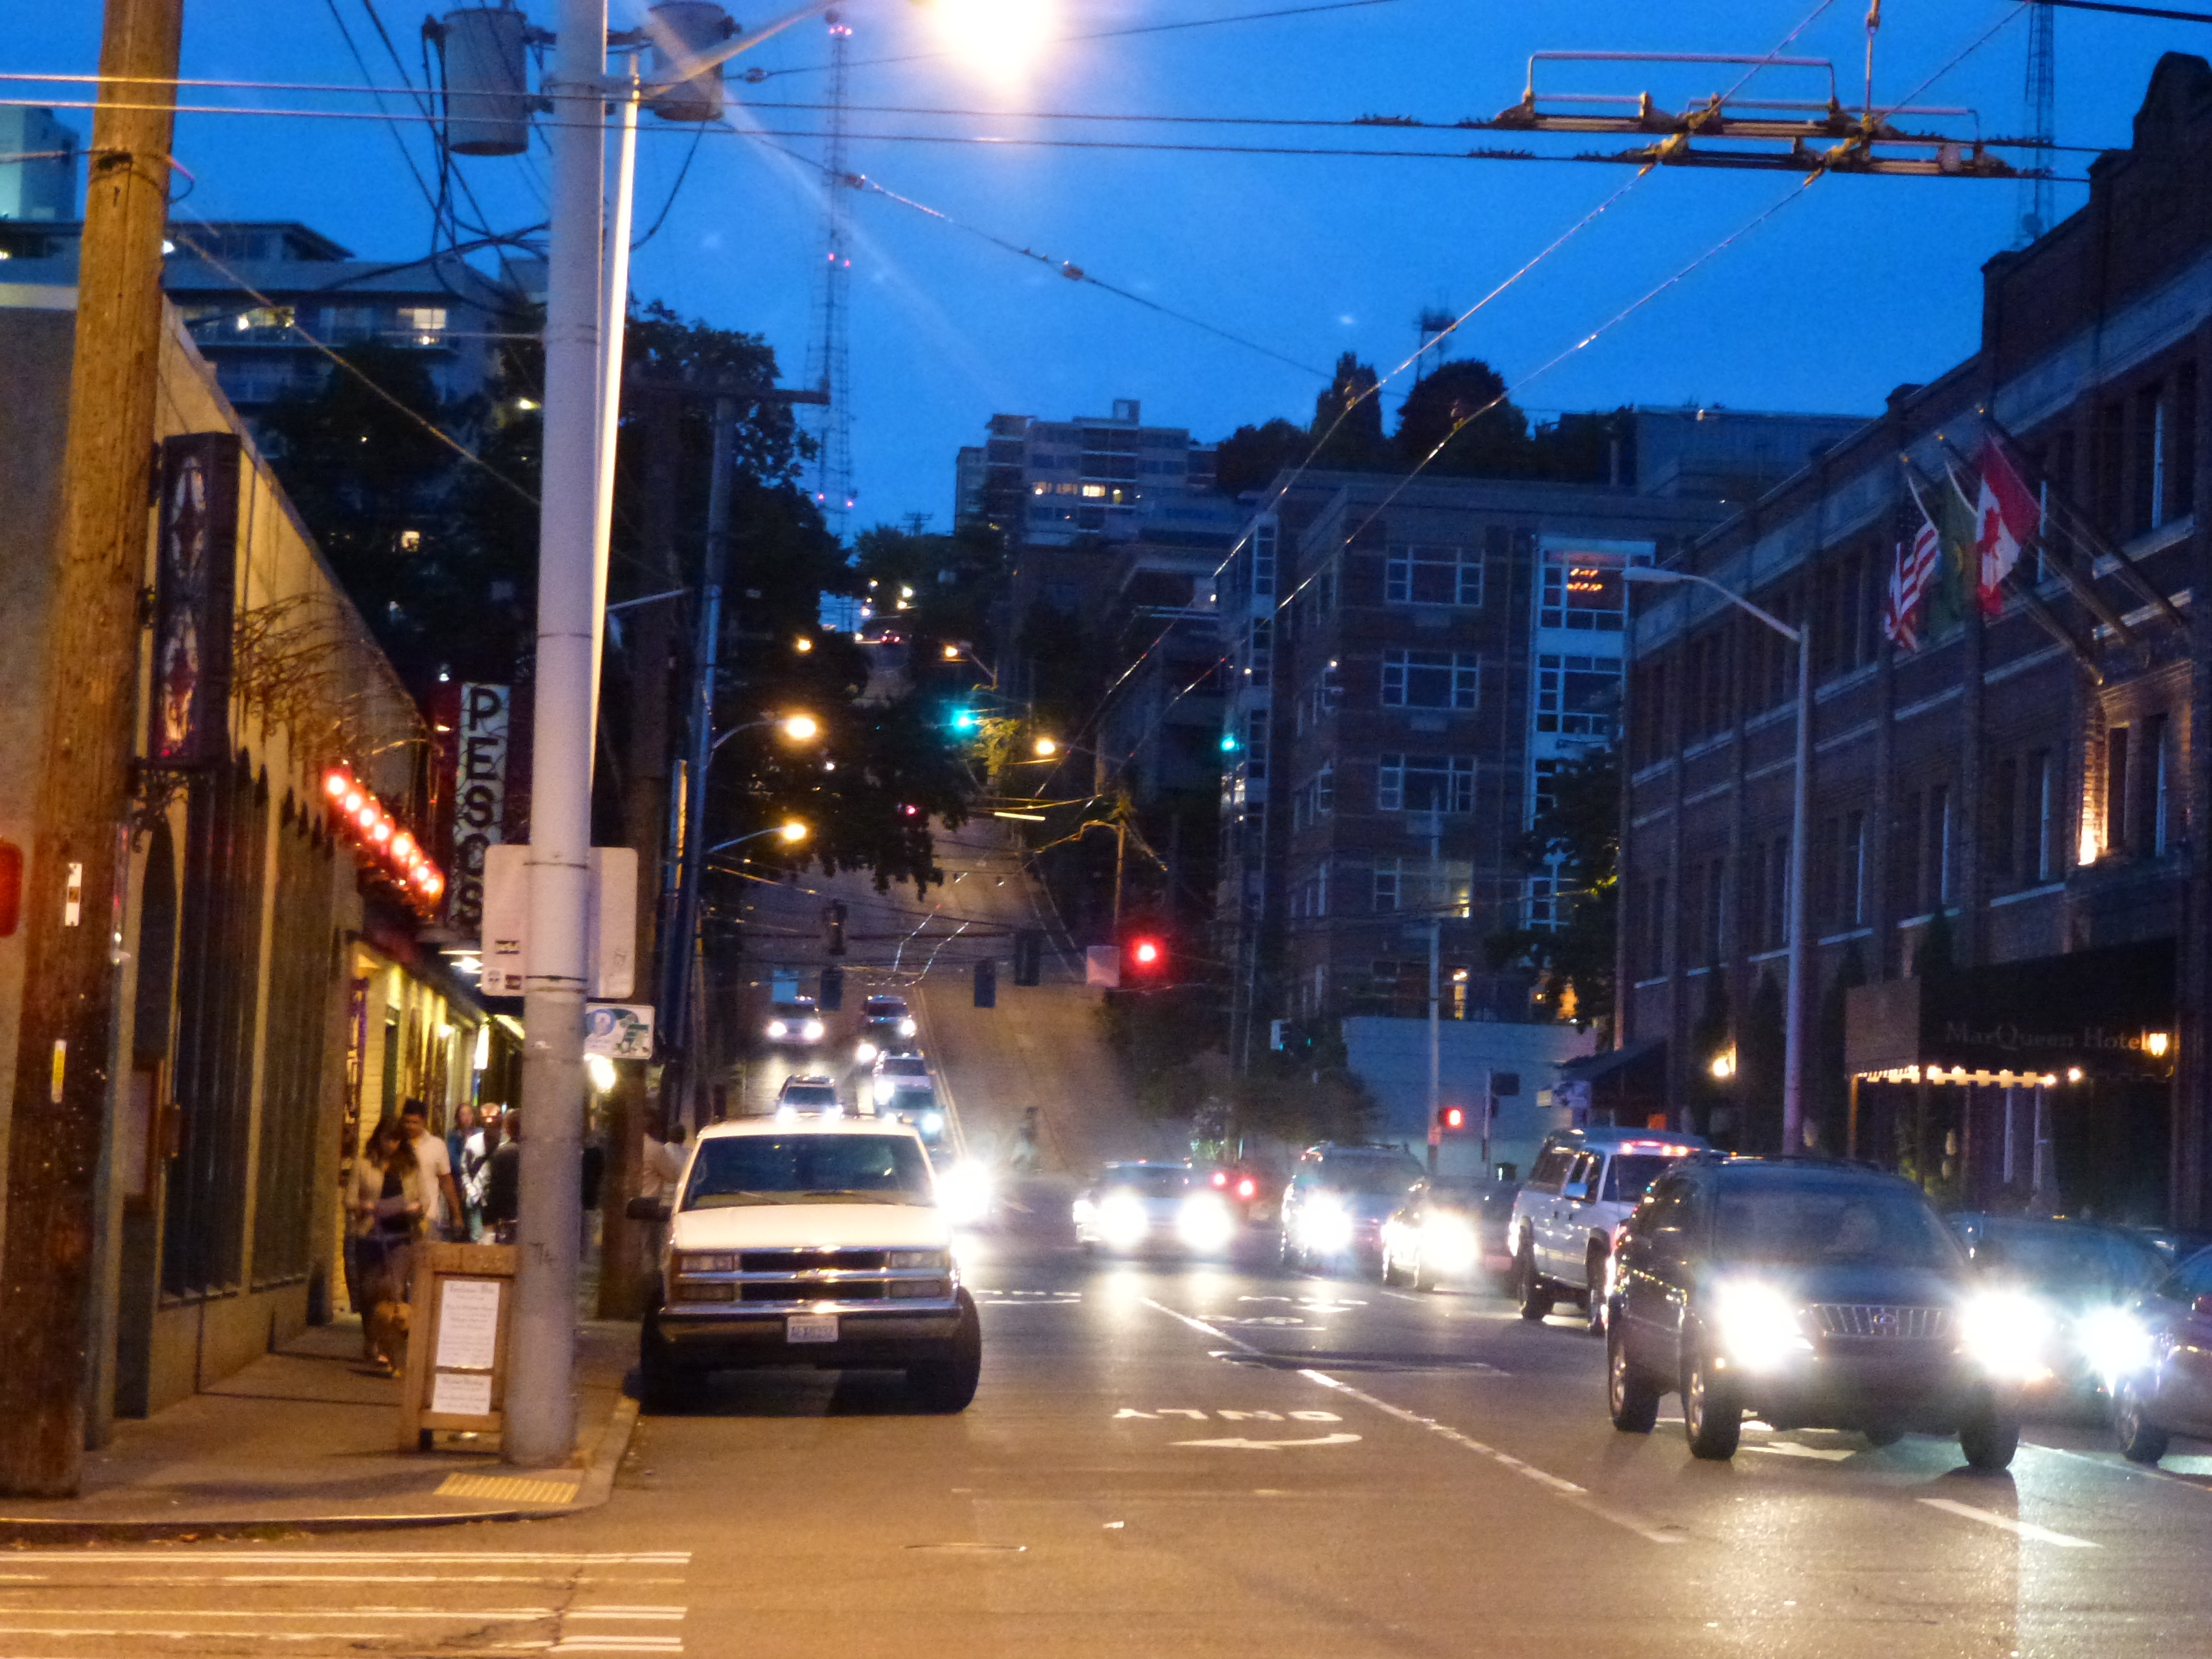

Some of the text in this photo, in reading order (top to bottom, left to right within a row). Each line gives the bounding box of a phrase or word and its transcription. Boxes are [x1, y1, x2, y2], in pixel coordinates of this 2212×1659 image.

[1946, 1021, 2146, 1051] MarQueen Hotel
[1113, 1408, 1344, 1421] ONLY
